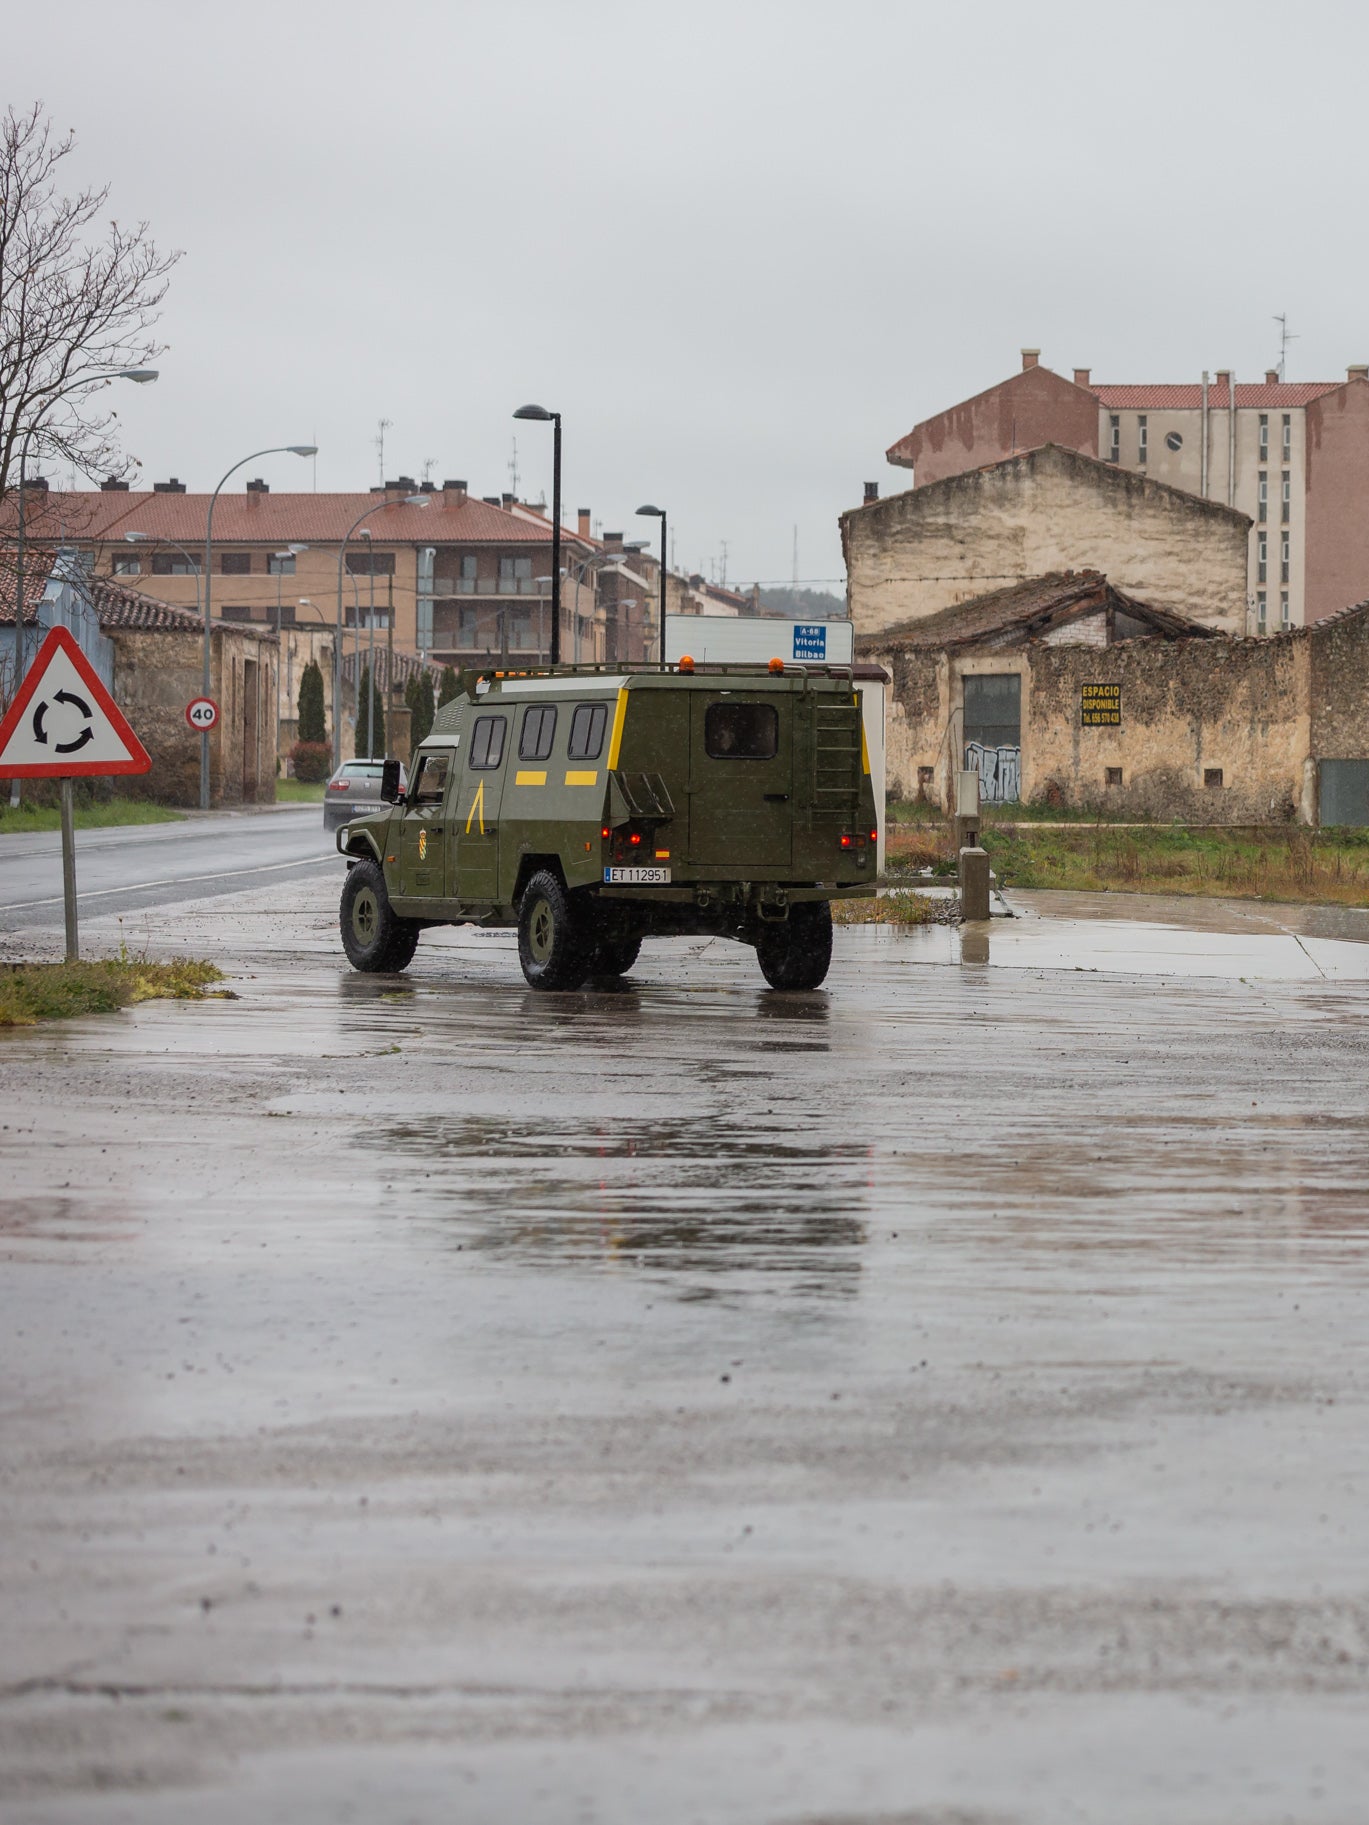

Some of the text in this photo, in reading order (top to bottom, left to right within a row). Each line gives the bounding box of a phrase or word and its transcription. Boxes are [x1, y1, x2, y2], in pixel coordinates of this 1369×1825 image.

[795, 638, 825, 647] Vitoria
[795, 650, 824, 659] Bilbao
[1083, 686, 1119, 697] ESPACIO
[1083, 699, 1119, 710] DISPONIBLE
[192, 709, 213, 720] 40
[612, 869, 667, 881] ET 112951
